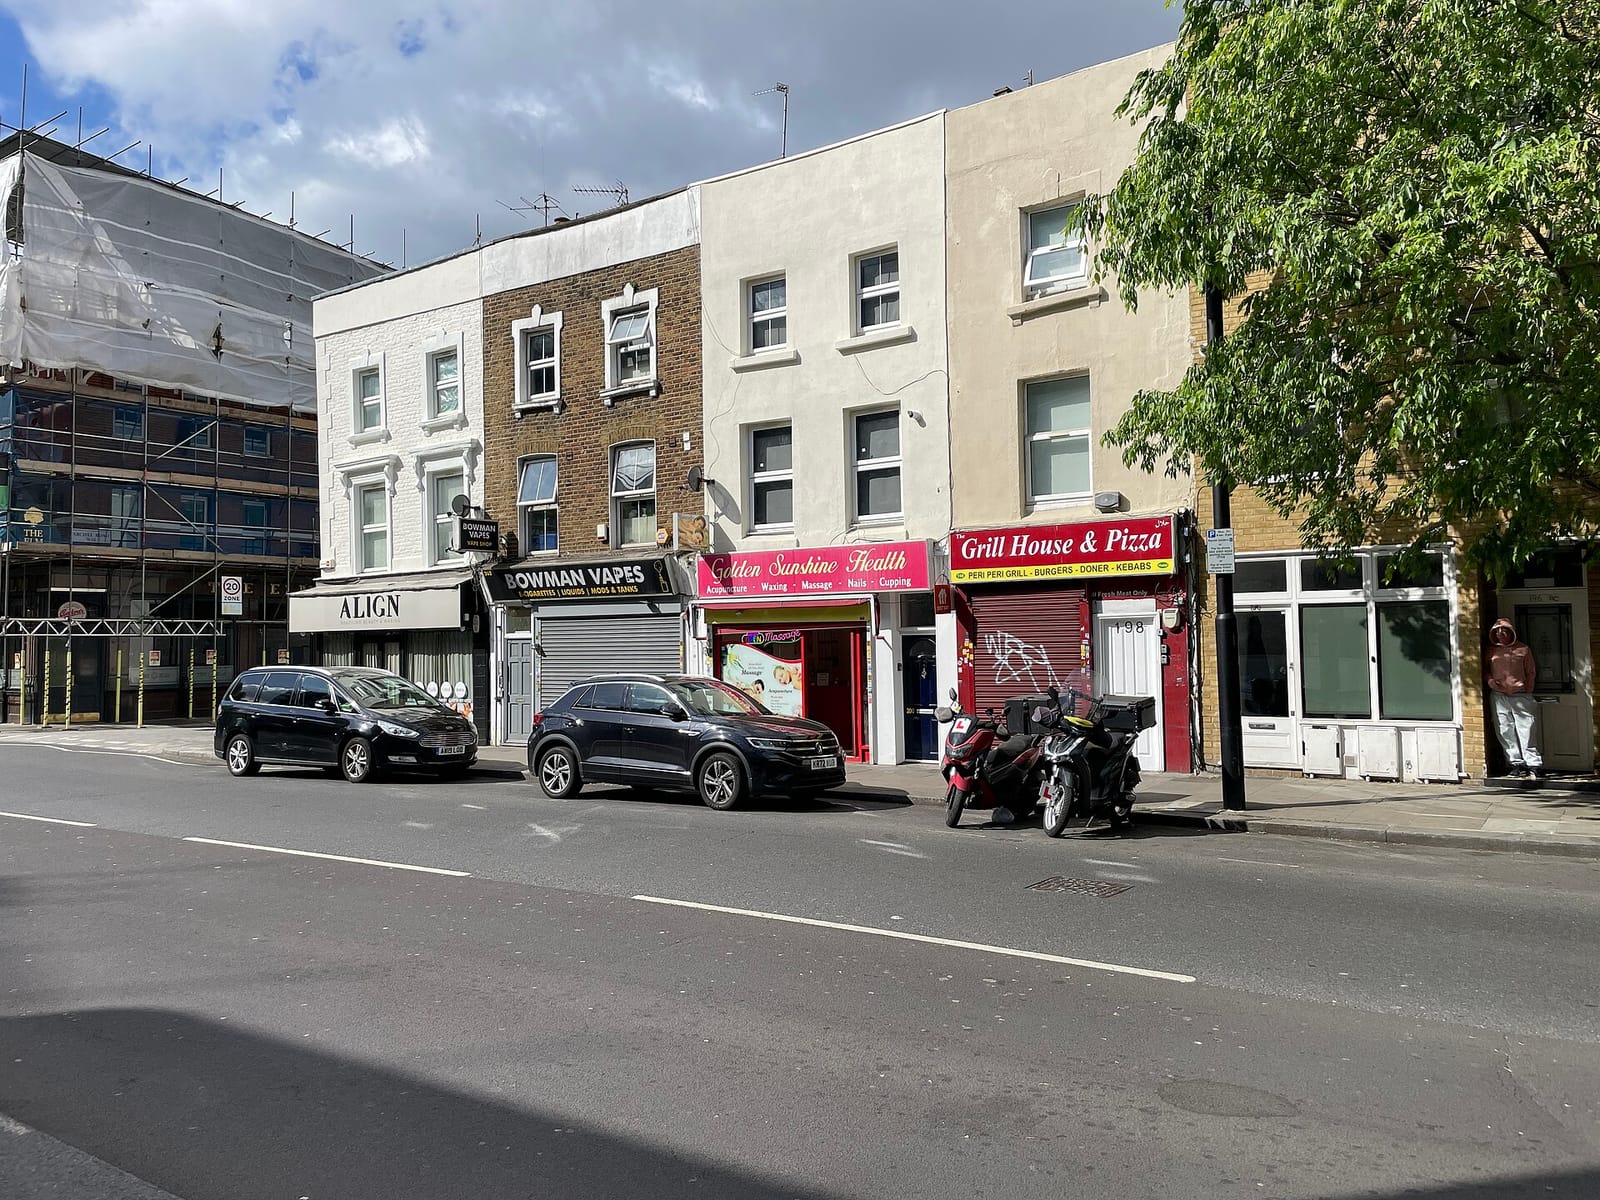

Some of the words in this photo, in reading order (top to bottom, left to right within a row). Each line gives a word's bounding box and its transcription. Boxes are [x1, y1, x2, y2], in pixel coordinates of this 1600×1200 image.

[24, 529, 43, 537] THE
[462, 523, 496, 532] BOWMAN
[469, 531, 490, 539] VAPES
[961, 535, 1005, 559] Grill
[1009, 534, 1074, 556] House
[1079, 530, 1098, 553] &
[1104, 528, 1162, 552] Pizza
[711, 558, 761, 584] Golden
[769, 553, 839, 576] Sunshine
[845, 548, 907, 573] Health
[968, 571, 985, 579] PERI
[986, 570, 1004, 578] PERI
[1005, 569, 1028, 577] GRILL
[1034, 566, 1073, 576] BURGERS
[1080, 564, 1109, 573] DONER
[1116, 562, 1152, 571] KEBABS
[504, 569, 586, 589] BOWMAN
[588, 565, 645, 585] VAPES
[226, 583, 238, 591] 20
[560, 588, 585, 596] LIQUIDS
[591, 587, 610, 595] MODS
[617, 585, 639, 593] TANKS
[706, 585, 748, 595] Acupuncture
[761, 582, 788, 592] Waxing
[801, 580, 832, 590] Massage
[847, 578, 867, 588] Nails
[879, 577, 912, 588] Cupping
[340, 595, 401, 619] ALIGN
[1115, 621, 1144, 634] 198
[764, 629, 800, 643] Massage
[956, 720, 964, 729] L
[1043, 786, 1053, 800] L
